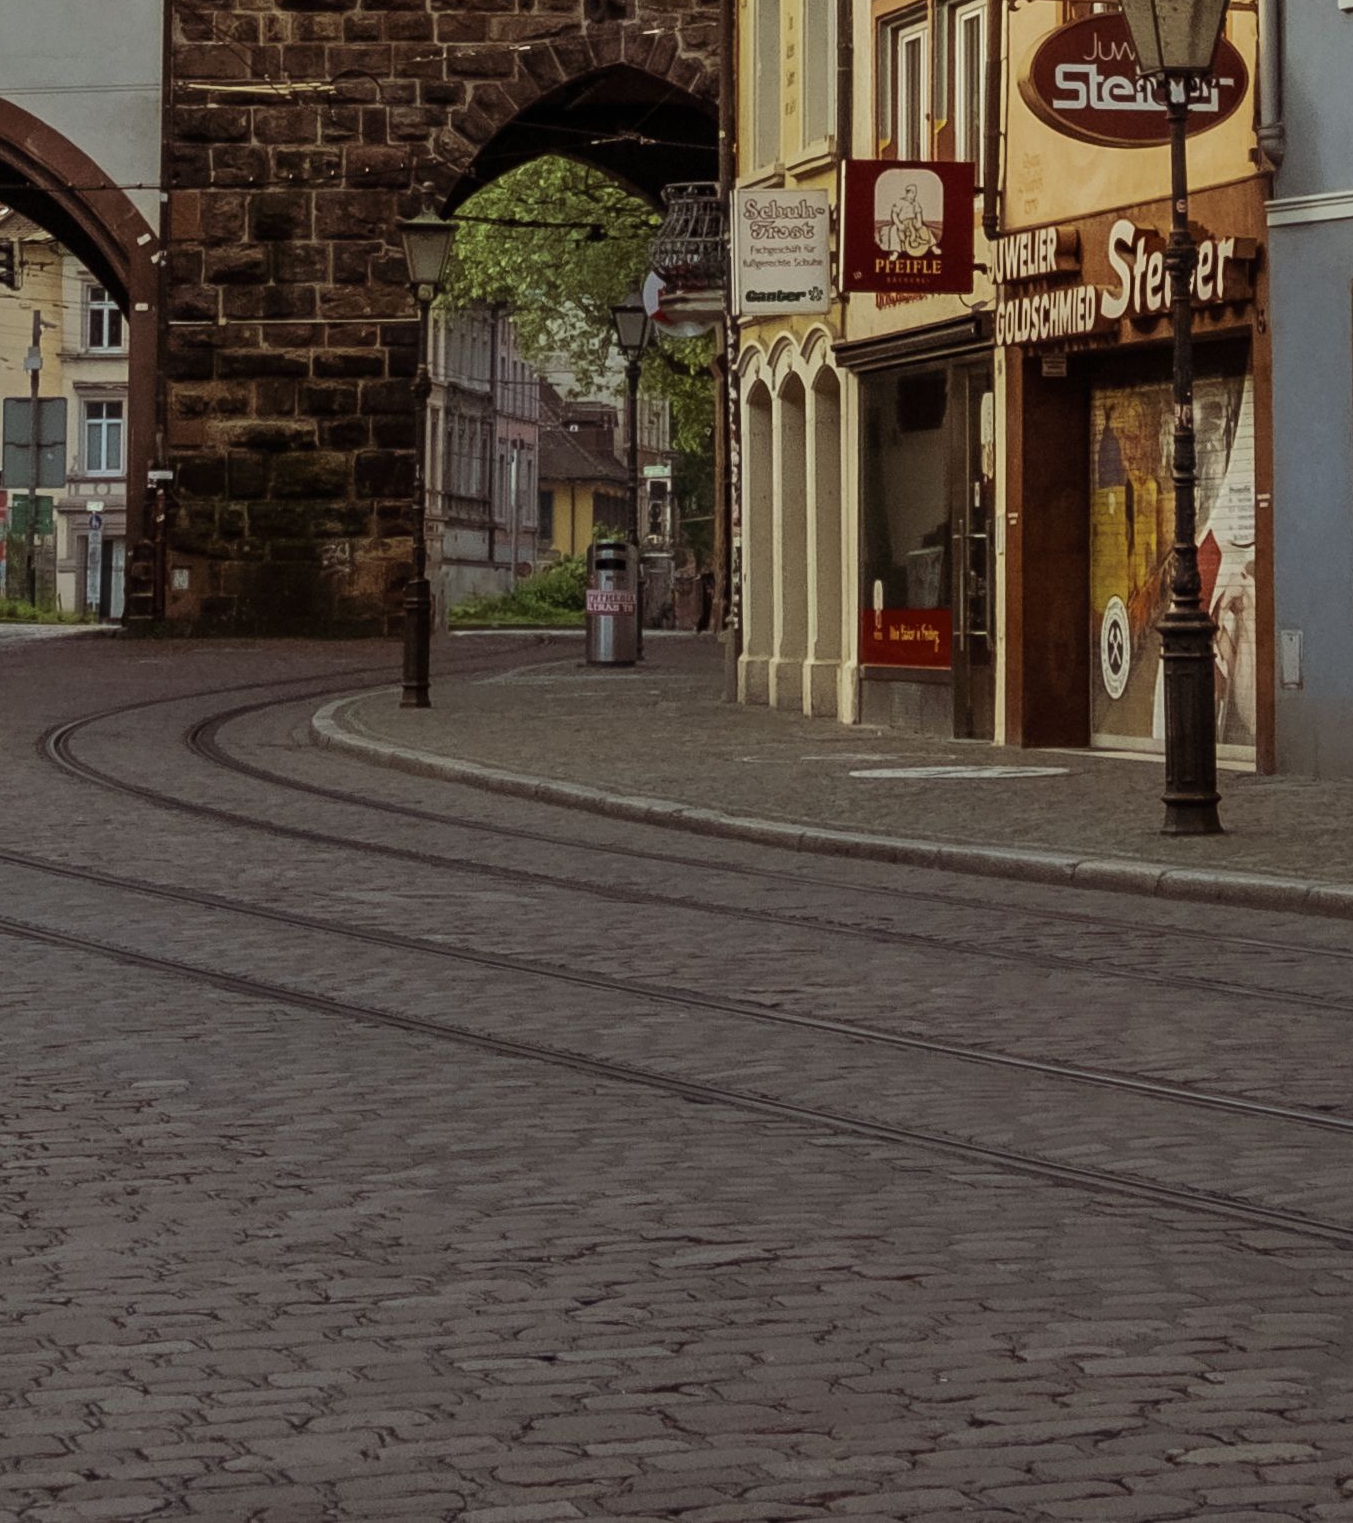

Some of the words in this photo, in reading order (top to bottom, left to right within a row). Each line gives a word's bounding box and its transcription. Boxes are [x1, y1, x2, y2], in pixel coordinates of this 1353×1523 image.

[1052, 62, 1235, 114] Steer
[742, 198, 827, 221] Schuh-
[874, 257, 944, 275] PFEIFLE
[1100, 218, 1236, 320] Steer
[745, 288, 807, 303] Ganter
[995, 284, 1096, 346] GOLDSCHMIED
